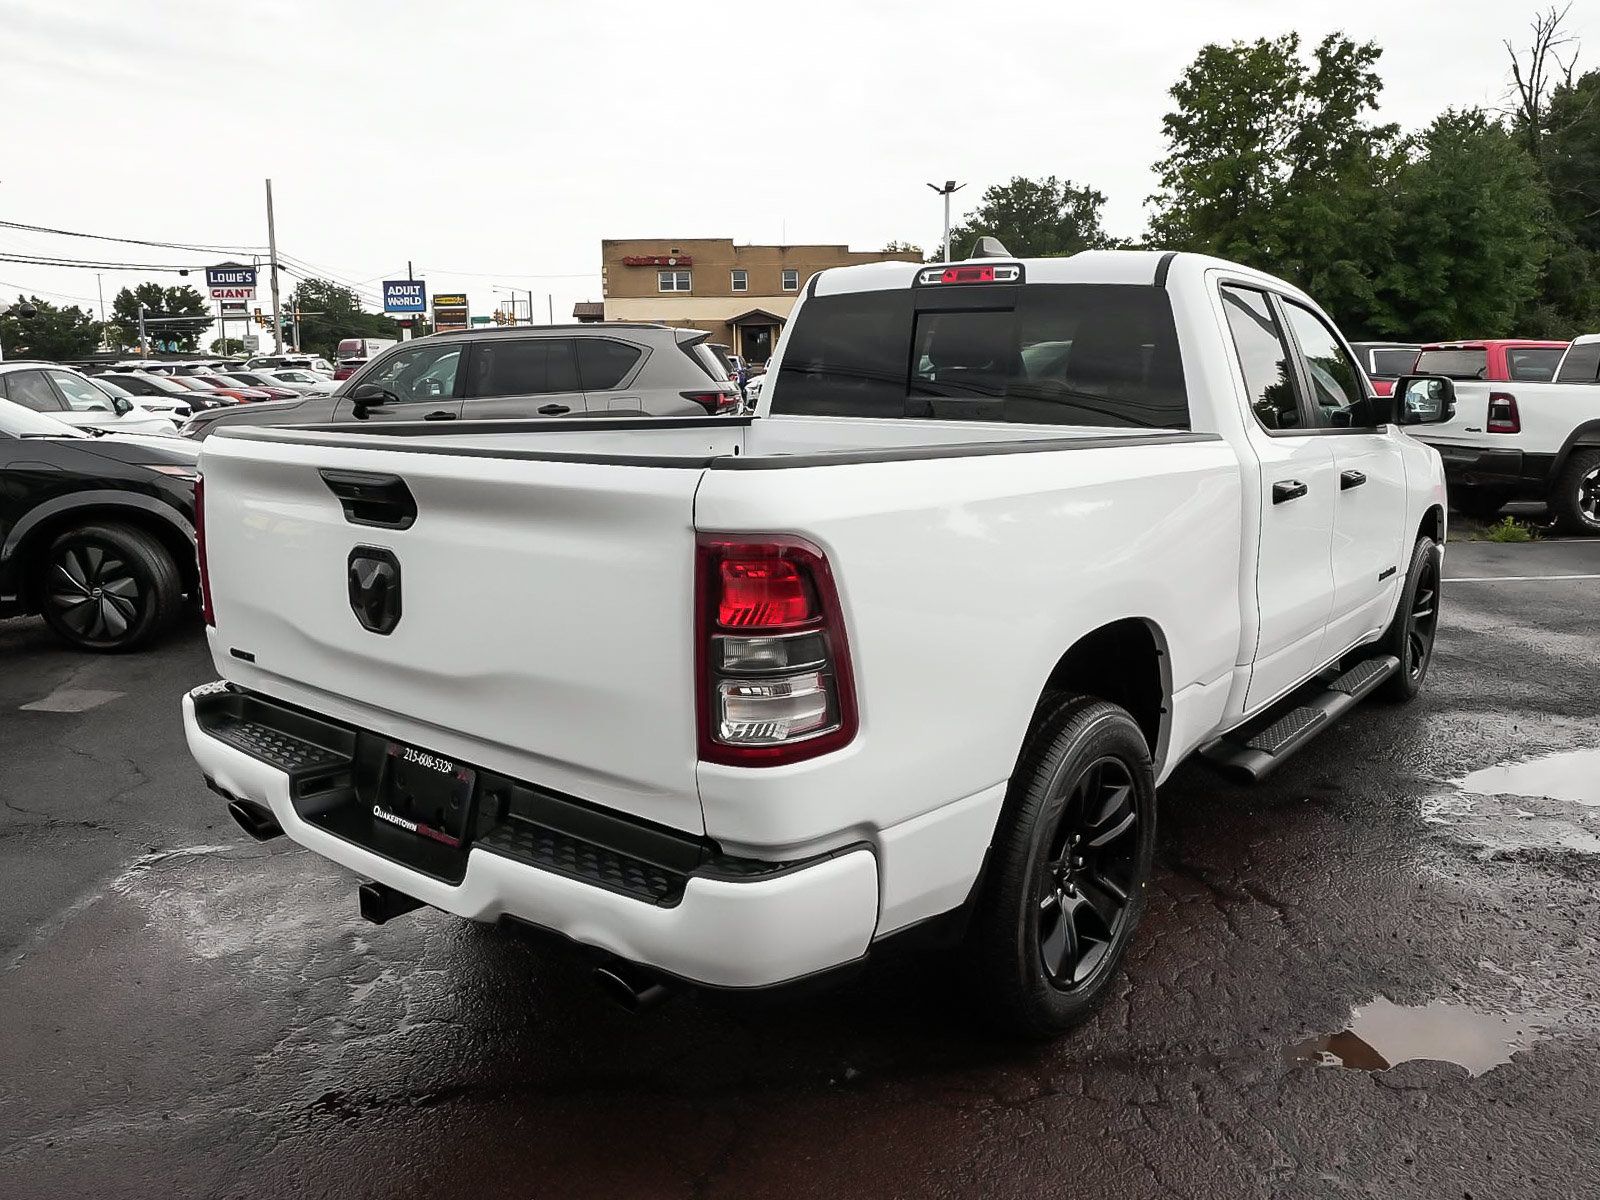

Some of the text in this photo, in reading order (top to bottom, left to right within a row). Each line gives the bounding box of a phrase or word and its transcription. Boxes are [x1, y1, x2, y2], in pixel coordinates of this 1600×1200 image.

[210, 271, 252, 283] LOWE'S
[212, 289, 252, 298] GIANT
[387, 286, 421, 295] ADULT
[387, 297, 422, 306] WORLD
[403, 747, 453, 773] 215-608-5328
[373, 805, 417, 832] QUAKERTOWN
